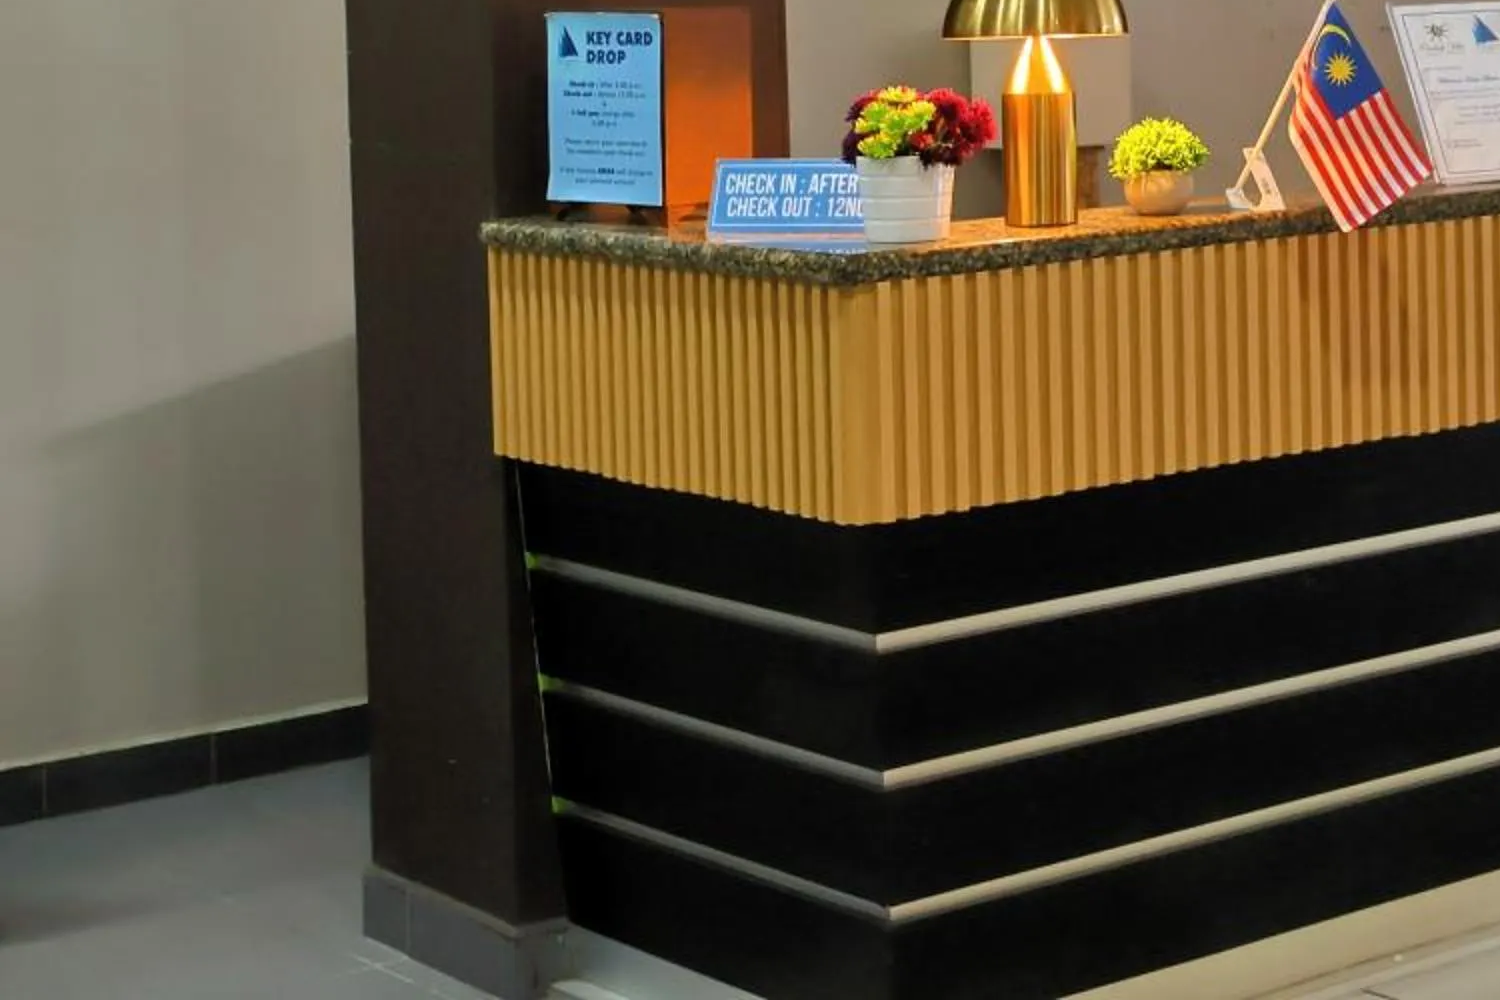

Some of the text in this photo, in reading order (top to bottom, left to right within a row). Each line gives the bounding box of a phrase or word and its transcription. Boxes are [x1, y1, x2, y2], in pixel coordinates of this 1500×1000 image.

[586, 31, 653, 47] KEY CARD
[586, 49, 626, 65] DROP
[726, 173, 777, 194] CHECK
[780, 173, 797, 194] IN
[808, 173, 860, 194] AFTER
[727, 197, 777, 218] CHECK
[782, 197, 813, 217] OUT
